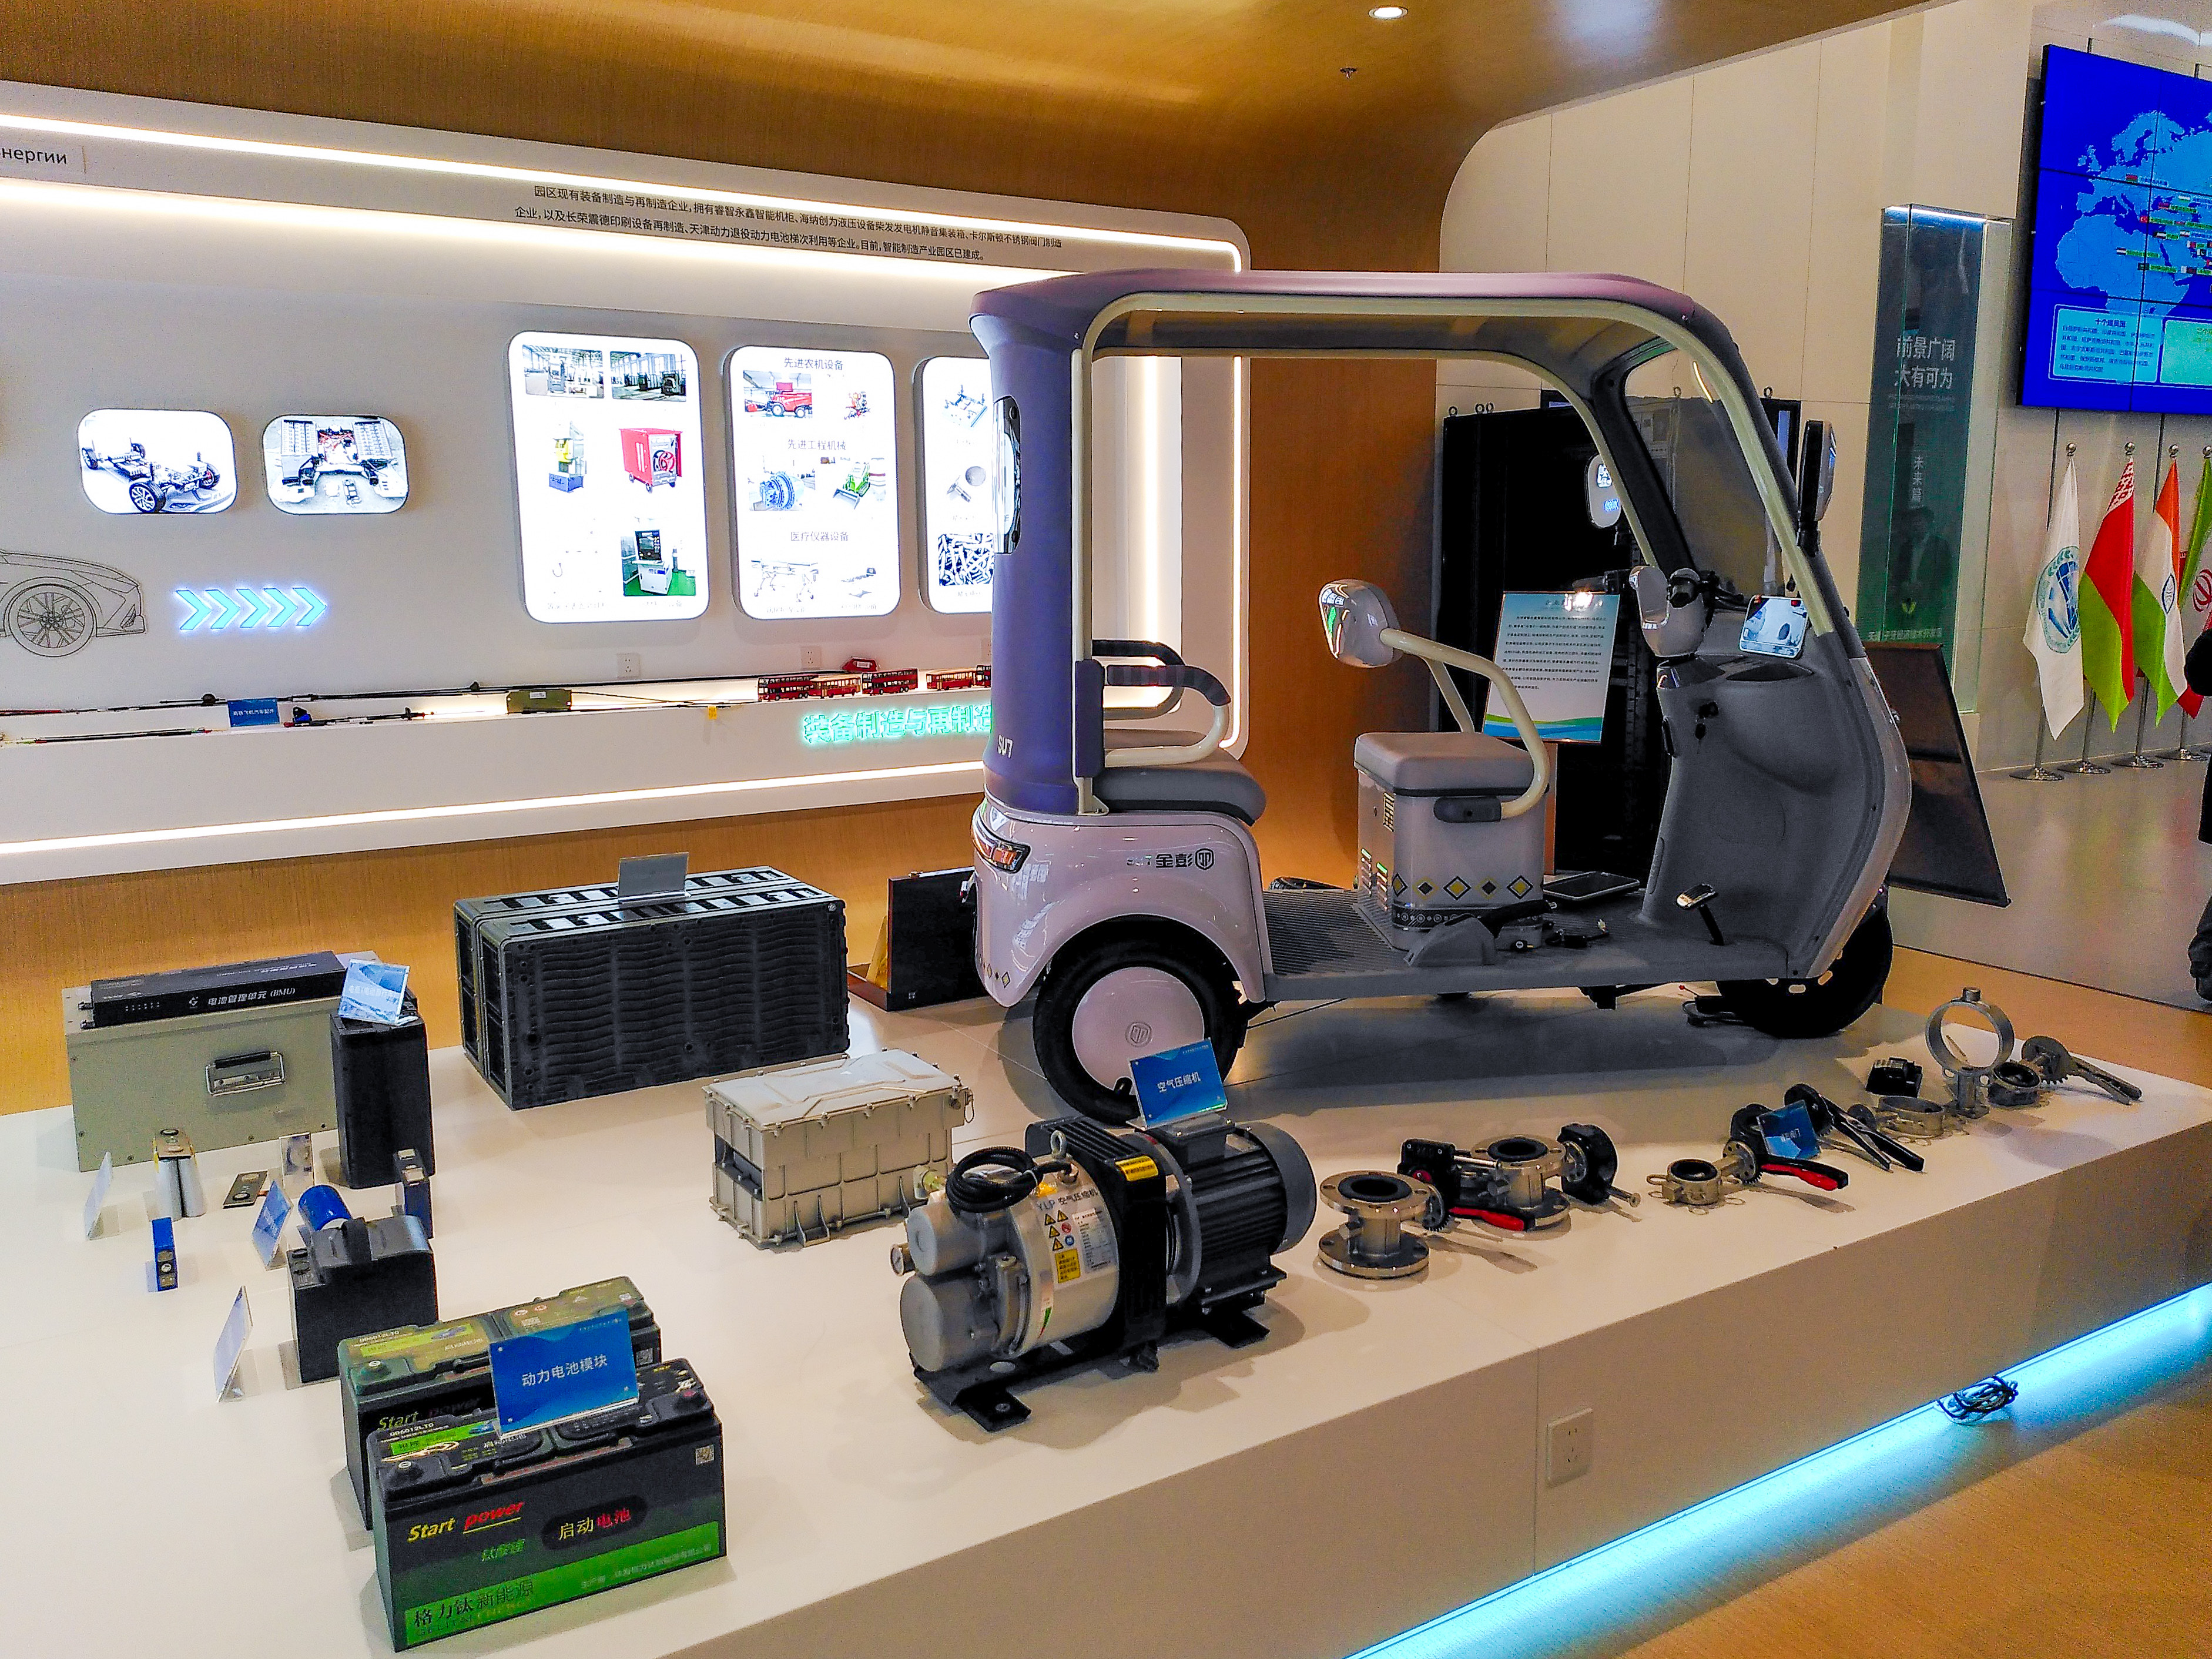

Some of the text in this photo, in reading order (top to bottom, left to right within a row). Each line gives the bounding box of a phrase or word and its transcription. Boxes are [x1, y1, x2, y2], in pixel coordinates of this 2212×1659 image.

[0, 148, 67, 164] нергии
[1895, 336, 1955, 361] 前景广阔
[784, 357, 844, 370] 先进农机设备
[1894, 364, 1953, 388] 大有可为
[787, 438, 846, 451] 先进工程机械
[790, 531, 849, 542] 医疗仪器设备
[803, 705, 992, 744] 装备制造与再制造
[997, 735, 1013, 758] SU7
[1155, 853, 1194, 868] 金彭
[207, 987, 296, 1006] 电池管理单元 (BMU)
[1157, 1071, 1201, 1093] 空气压缩机
[521, 1353, 608, 1387] 动力电池模块
[377, 1411, 418, 1430] Start
[407, 1500, 525, 1544] Start power
[558, 1507, 632, 1541] 启动电池
[414, 1579, 534, 1628] 格力钛新能源
